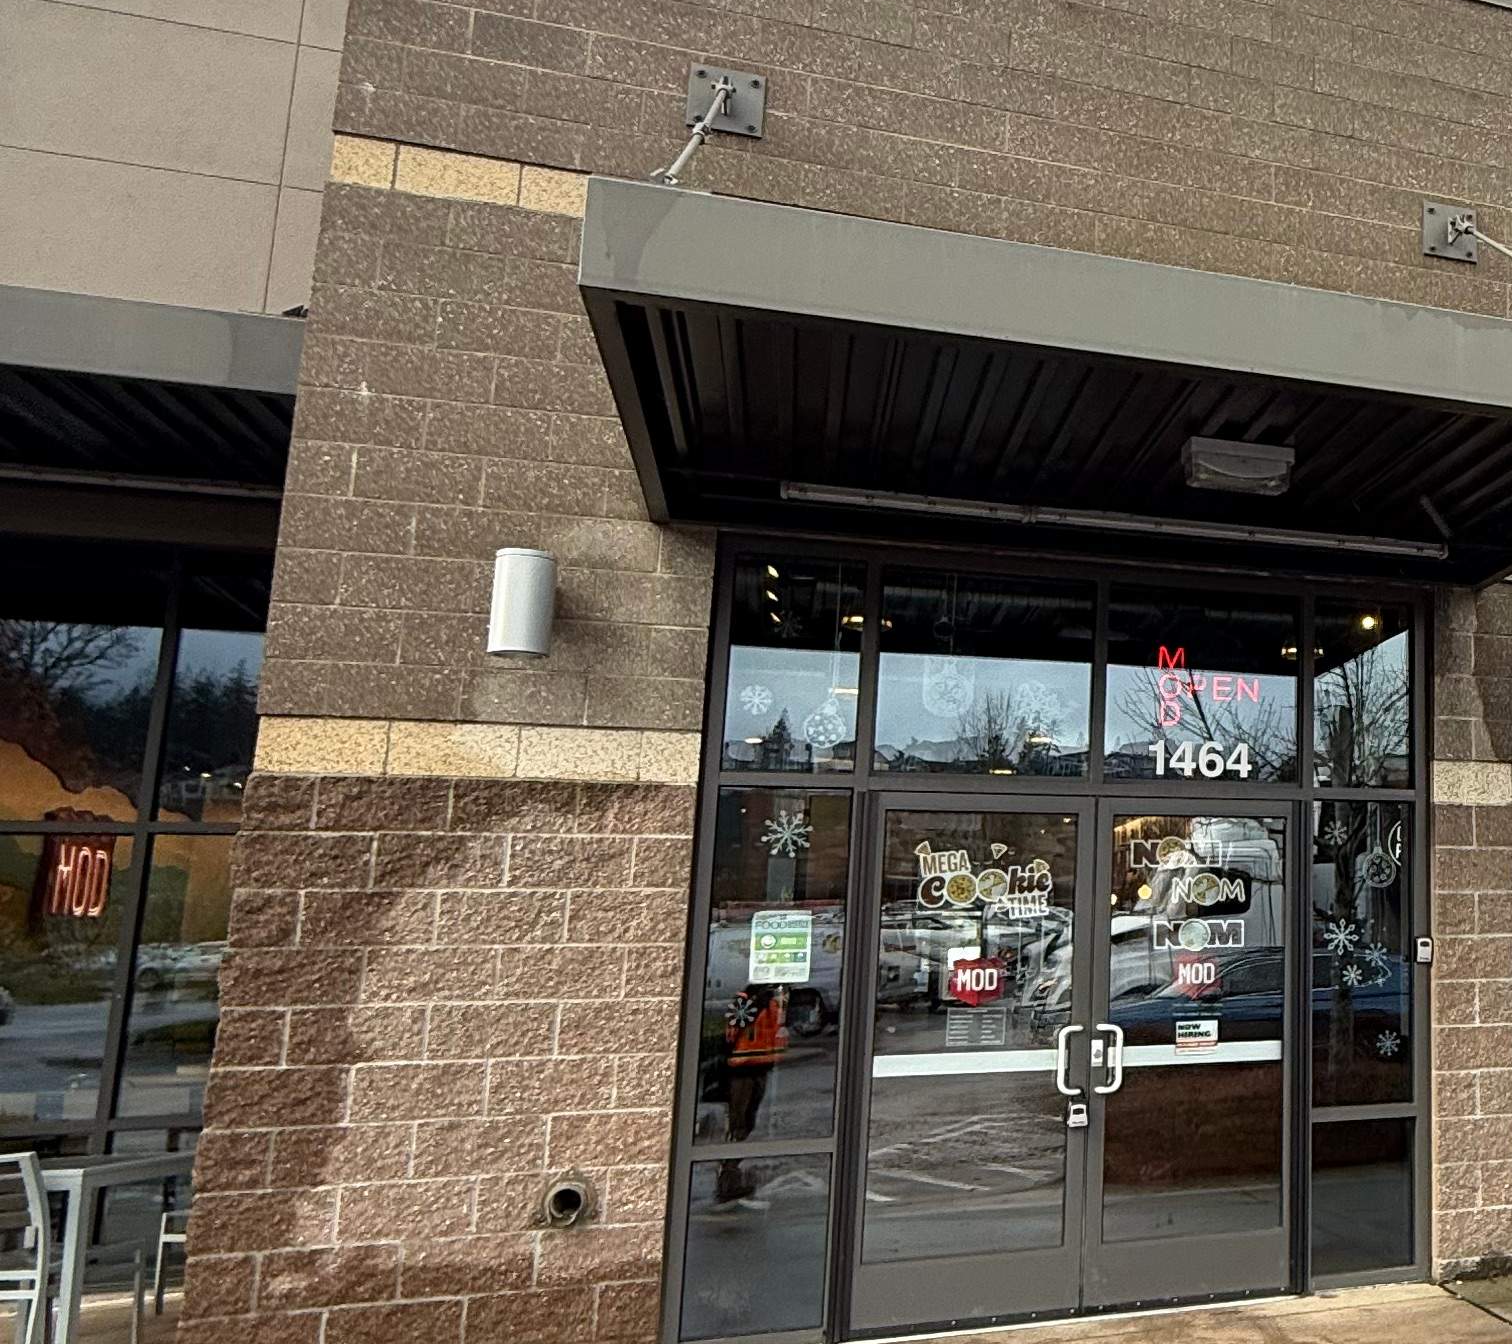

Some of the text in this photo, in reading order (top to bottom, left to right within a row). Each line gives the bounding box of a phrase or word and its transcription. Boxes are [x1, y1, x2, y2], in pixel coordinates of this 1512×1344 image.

[1159, 674, 1260, 703] OPEN
[1149, 739, 1252, 778] 1464
[920, 850, 970, 876] MEGA
[52, 844, 109, 917] MOD
[1171, 873, 1245, 906] NOM
[1007, 894, 1049, 918] TIME
[1153, 918, 1244, 951] NOM
[956, 968, 998, 991] MOD
[1178, 962, 1216, 985] MOD
[1178, 1031, 1211, 1039] HIRING
